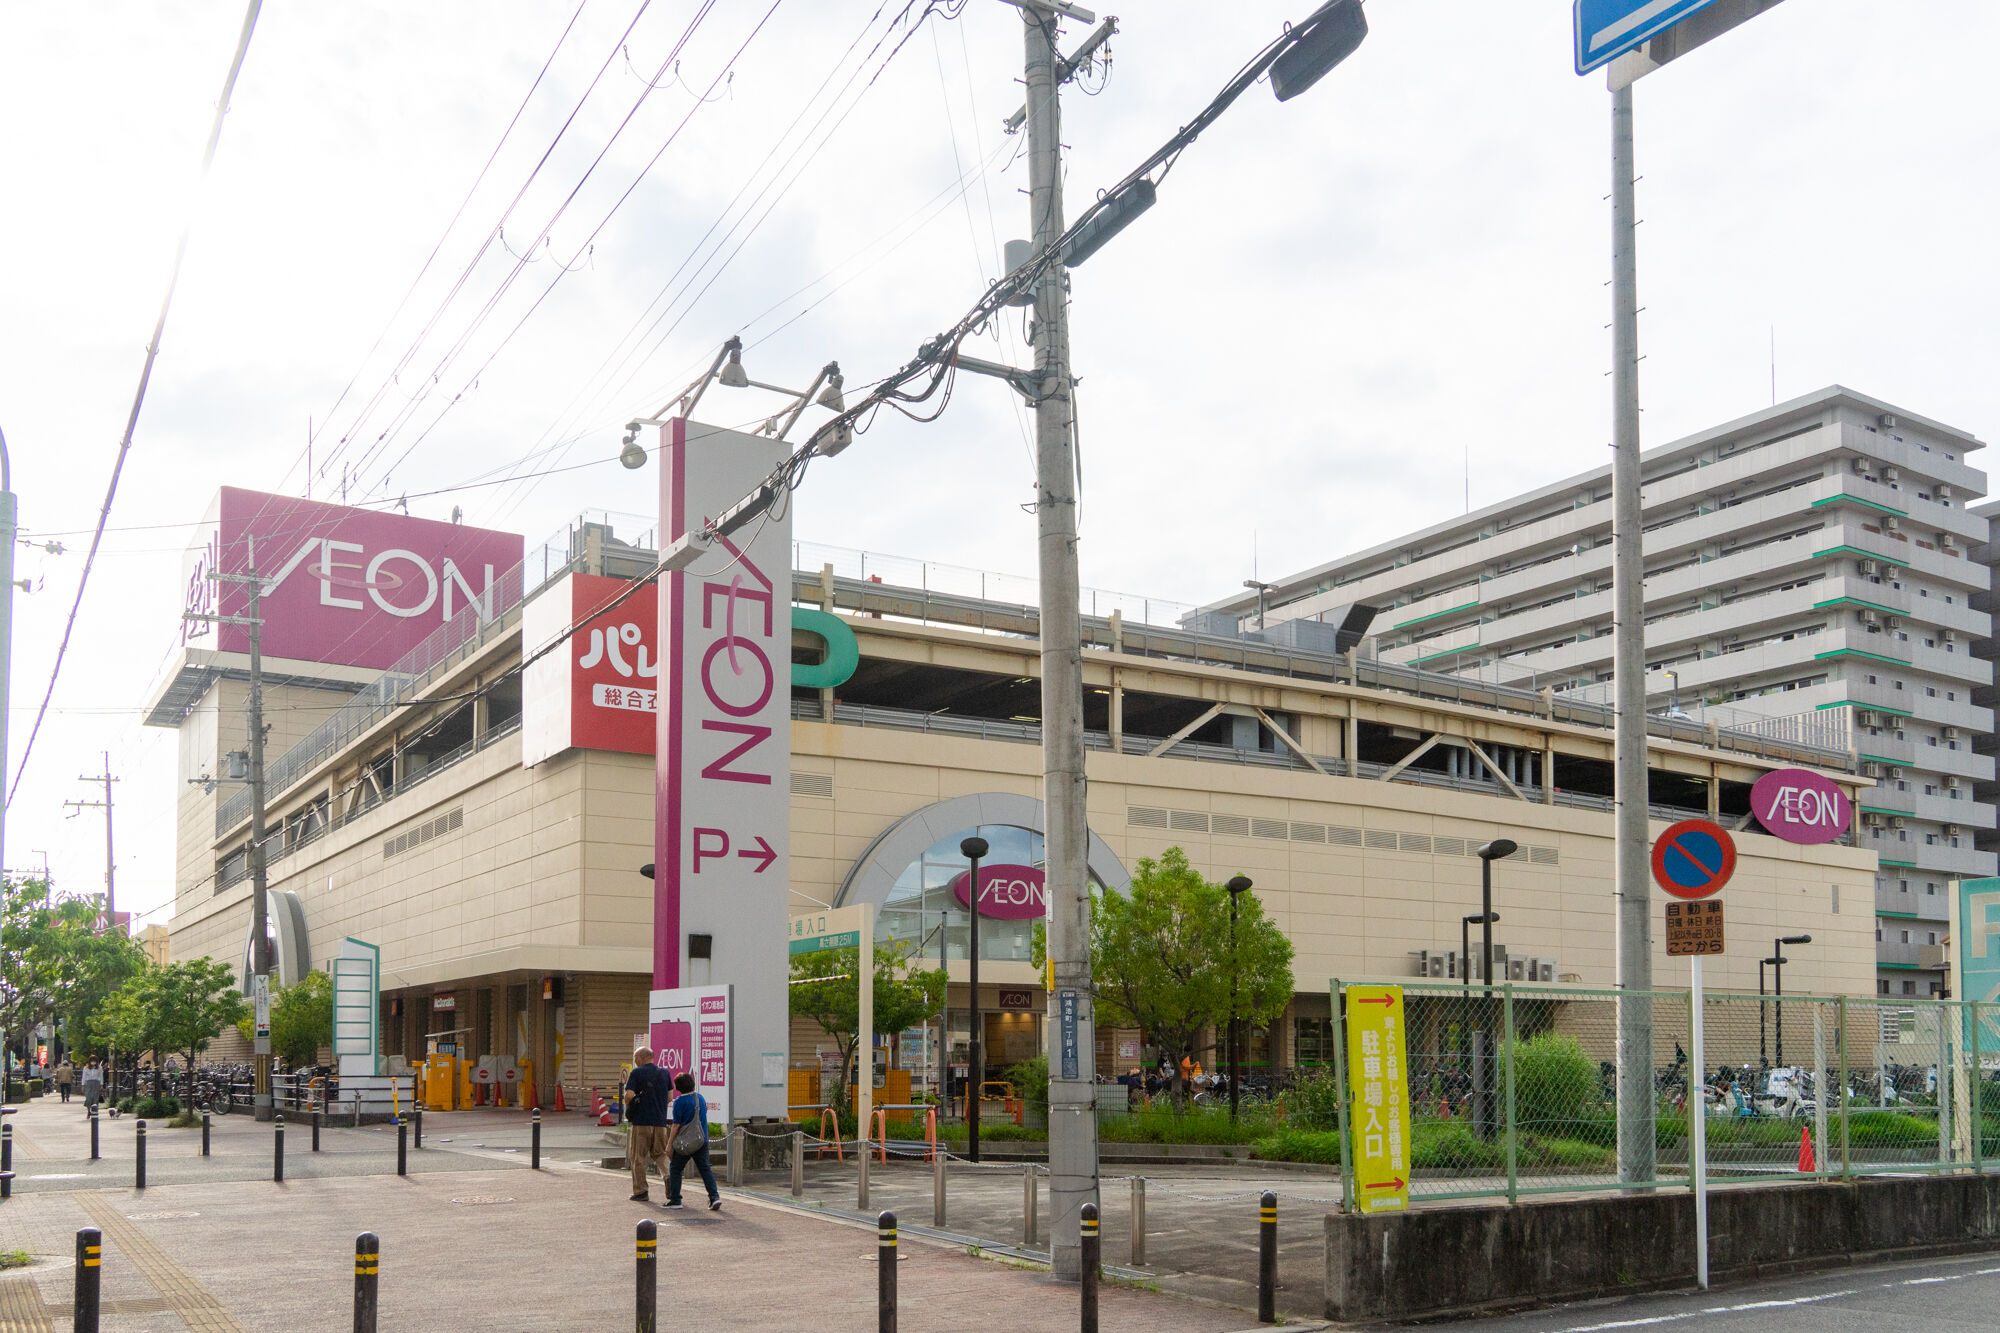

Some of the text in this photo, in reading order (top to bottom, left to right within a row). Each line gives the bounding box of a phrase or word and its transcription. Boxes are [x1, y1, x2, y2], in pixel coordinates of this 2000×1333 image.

[260, 537, 493, 622] AEON
[701, 516, 774, 785] AEON
[1766, 786, 1839, 828] AEON
[693, 827, 730, 874] P
[978, 878, 1046, 905] AEON
[1668, 901, 1721, 916] 自動車
[1669, 940, 1721, 953] ここから
[1002, 994, 1030, 1005] AEON
[657, 1048, 684, 1070] AEON
[1361, 1029, 1383, 1159] 駐車場入口
